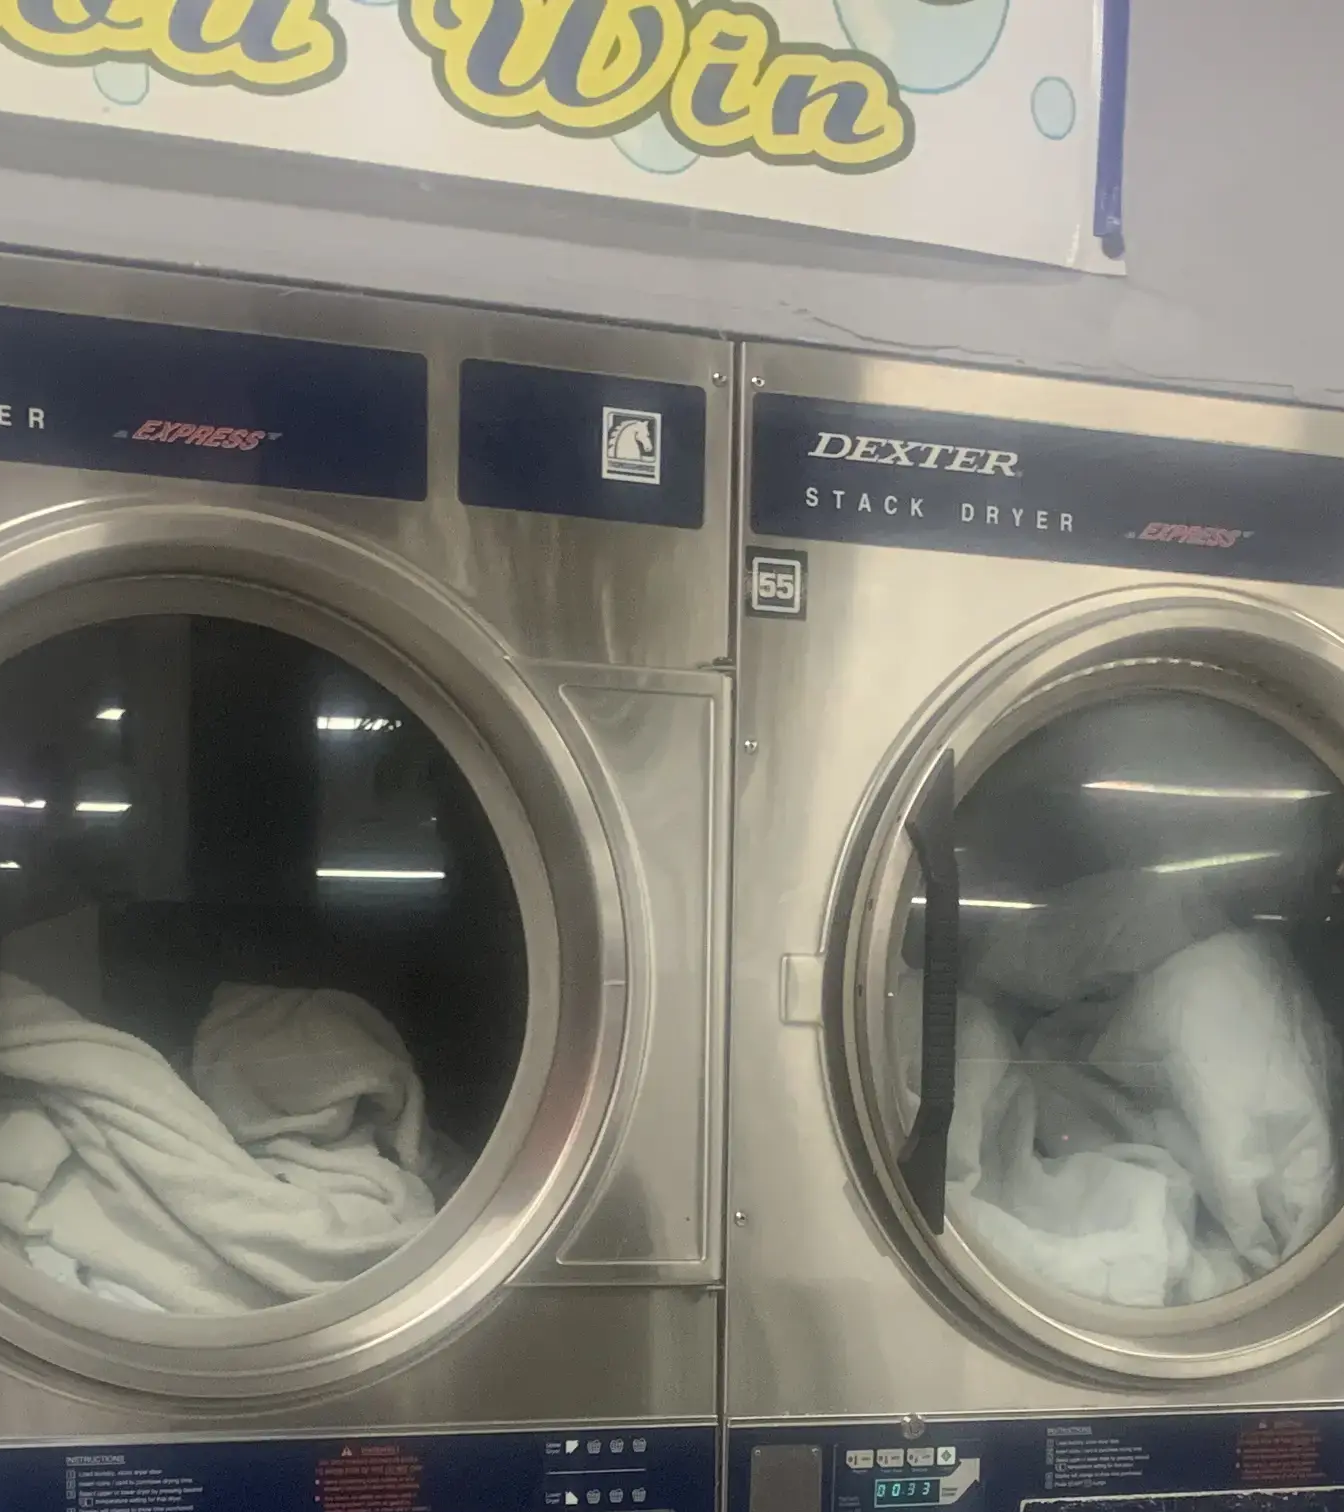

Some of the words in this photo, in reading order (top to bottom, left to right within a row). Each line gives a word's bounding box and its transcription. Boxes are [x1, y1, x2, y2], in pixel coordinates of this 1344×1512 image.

[413, 0, 904, 163] Win
[131, 419, 267, 451] EXPRESS
[808, 432, 1020, 477] DEXTER
[805, 488, 925, 518] STACK
[961, 503, 1074, 533] DRYER
[1139, 522, 1242, 548] EXPRESS
[758, 573, 795, 601] 55
